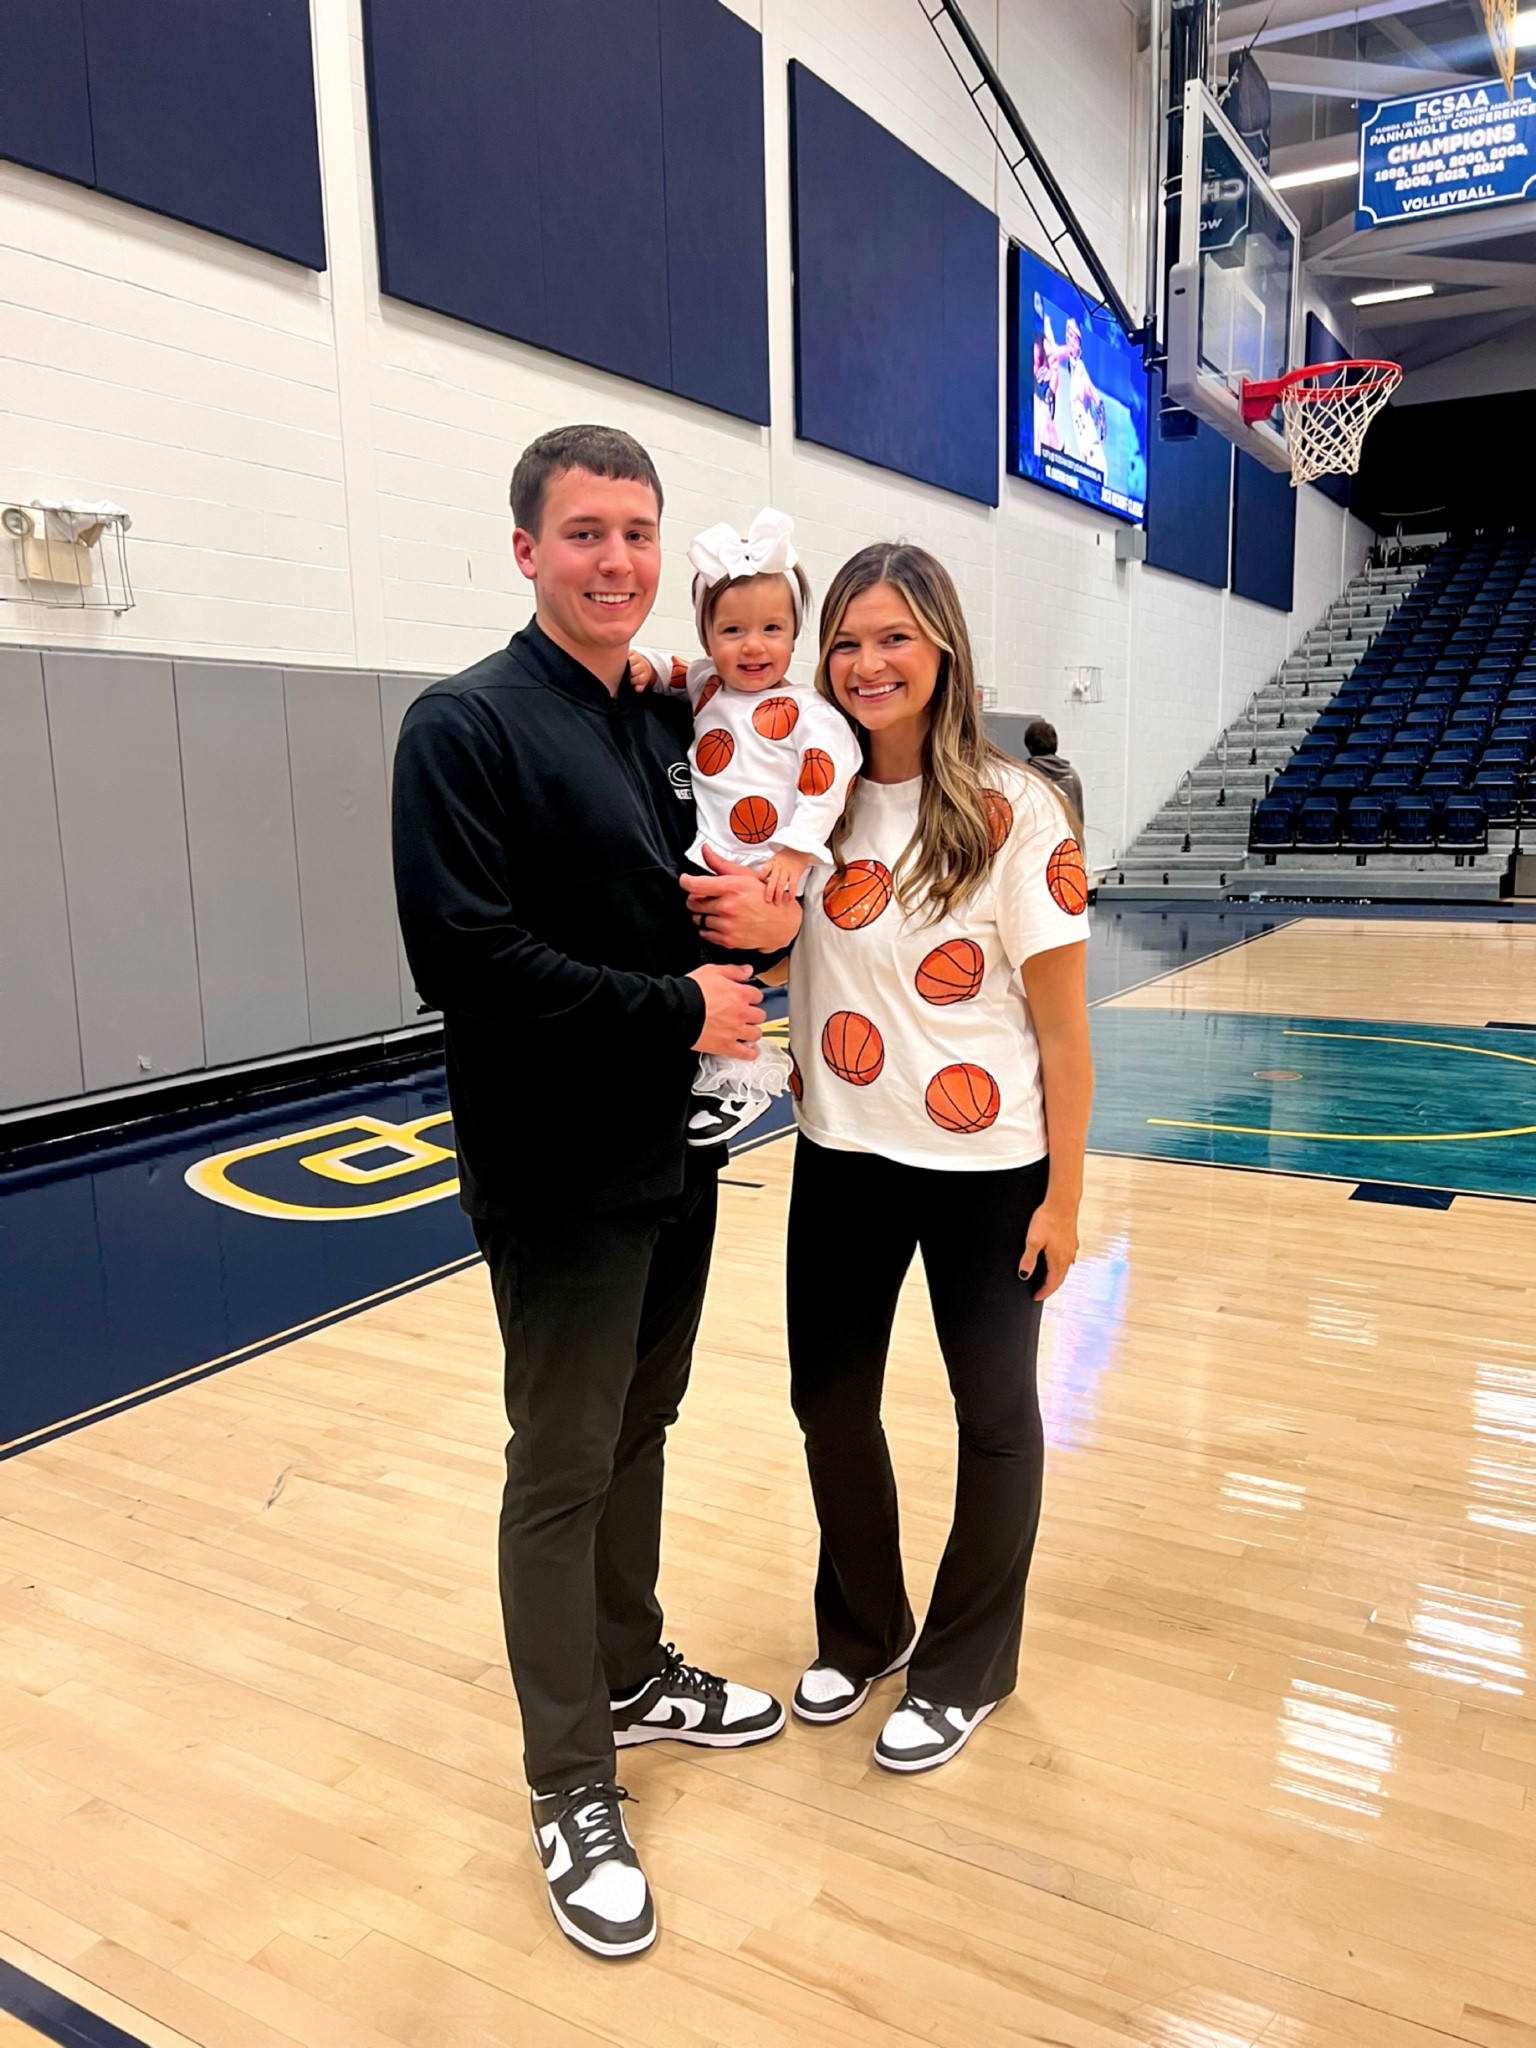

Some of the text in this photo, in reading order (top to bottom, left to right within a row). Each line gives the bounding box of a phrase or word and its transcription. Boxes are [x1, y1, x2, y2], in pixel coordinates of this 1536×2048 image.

[1415, 89, 1489, 119] FCSAA
[1370, 103, 1536, 146] PANHANDLE CONFERENCE
[1387, 123, 1516, 165] CHAMPIONS
[1473, 160, 1504, 178] 2014
[1402, 184, 1495, 213] VOLLEYBALL
